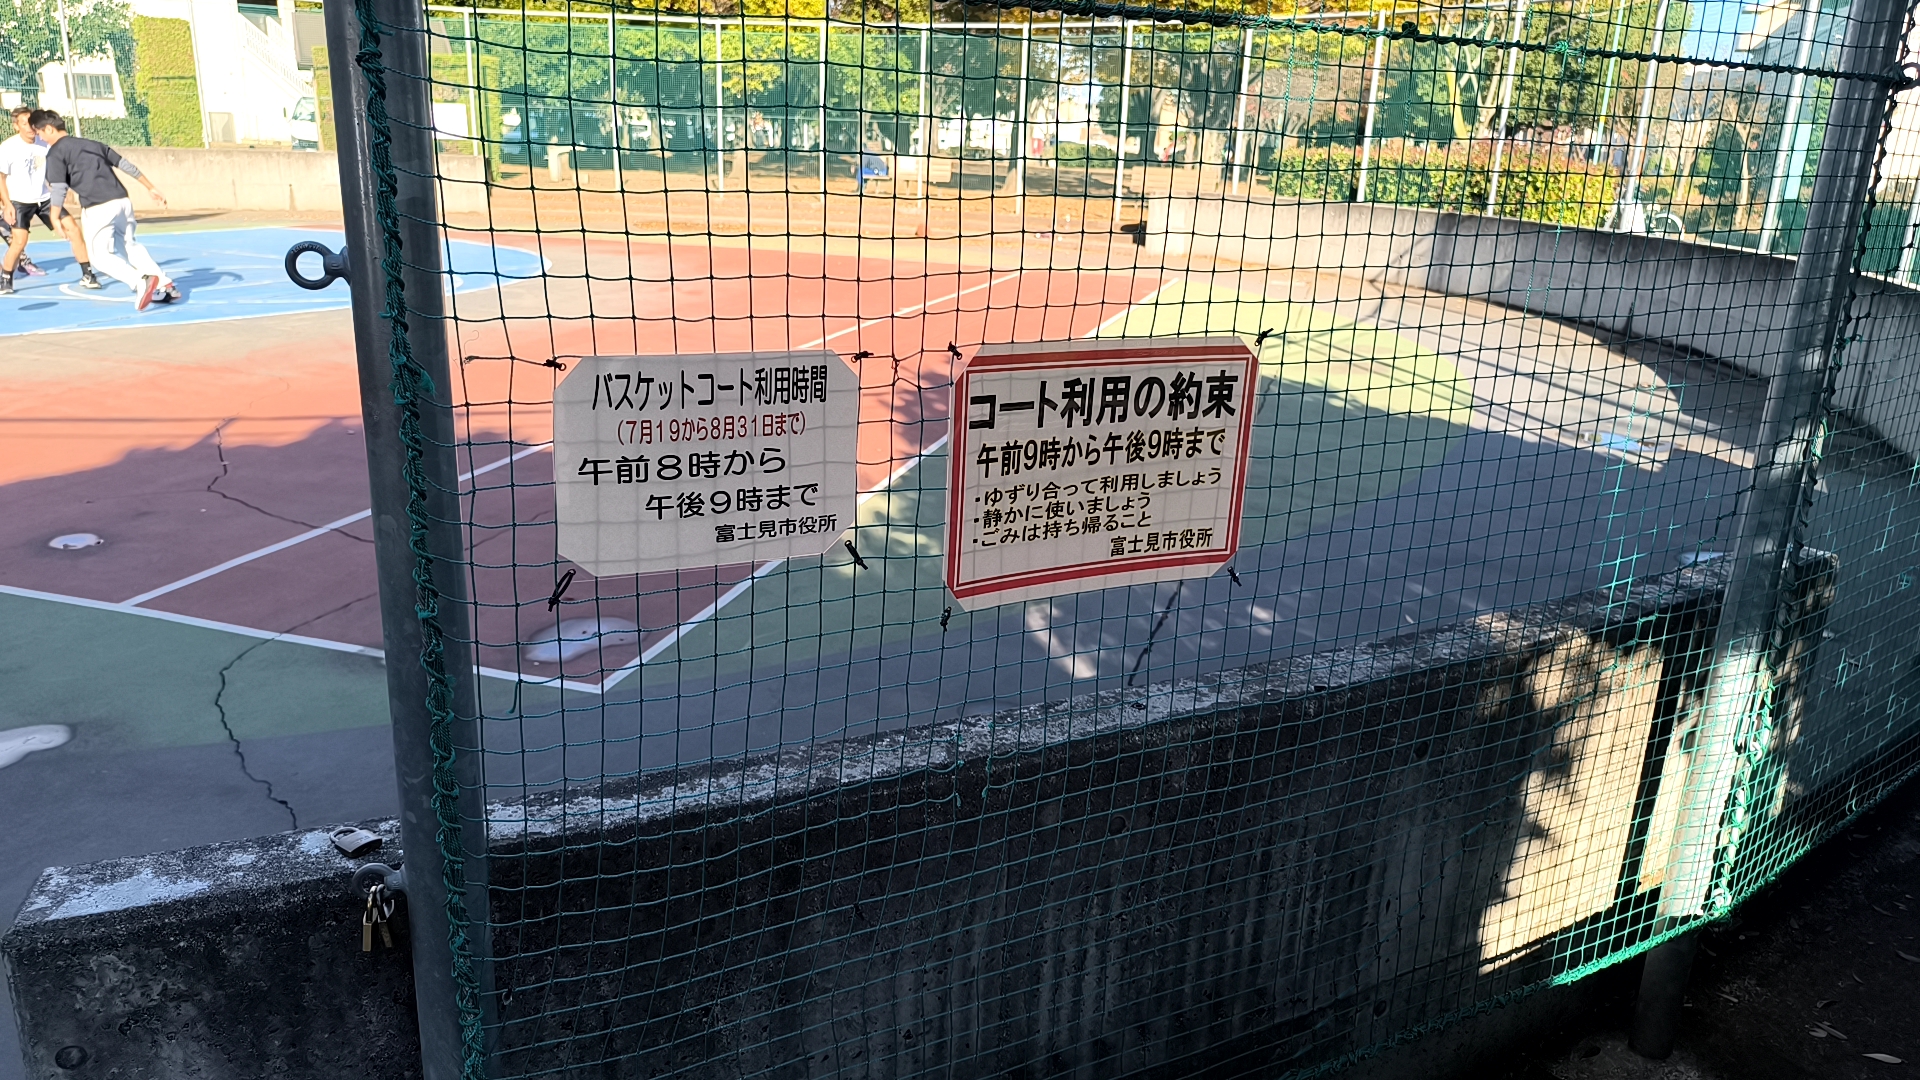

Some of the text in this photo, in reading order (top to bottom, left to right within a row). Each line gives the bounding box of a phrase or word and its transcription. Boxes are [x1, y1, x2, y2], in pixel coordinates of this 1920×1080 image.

[592, 365, 828, 411] バスケットコート利用時間
[968, 369, 1239, 430] コート利用の約束
[617, 411, 806, 446] (7月19から8月31日まで)
[577, 447, 786, 486] 午前8時から
[976, 427, 1226, 479] 午前9時から午後9時まで
[645, 482, 819, 520] 午後9時まで
[714, 513, 838, 543] 富士見市役所
[1110, 527, 1213, 557] 富士見市役所
